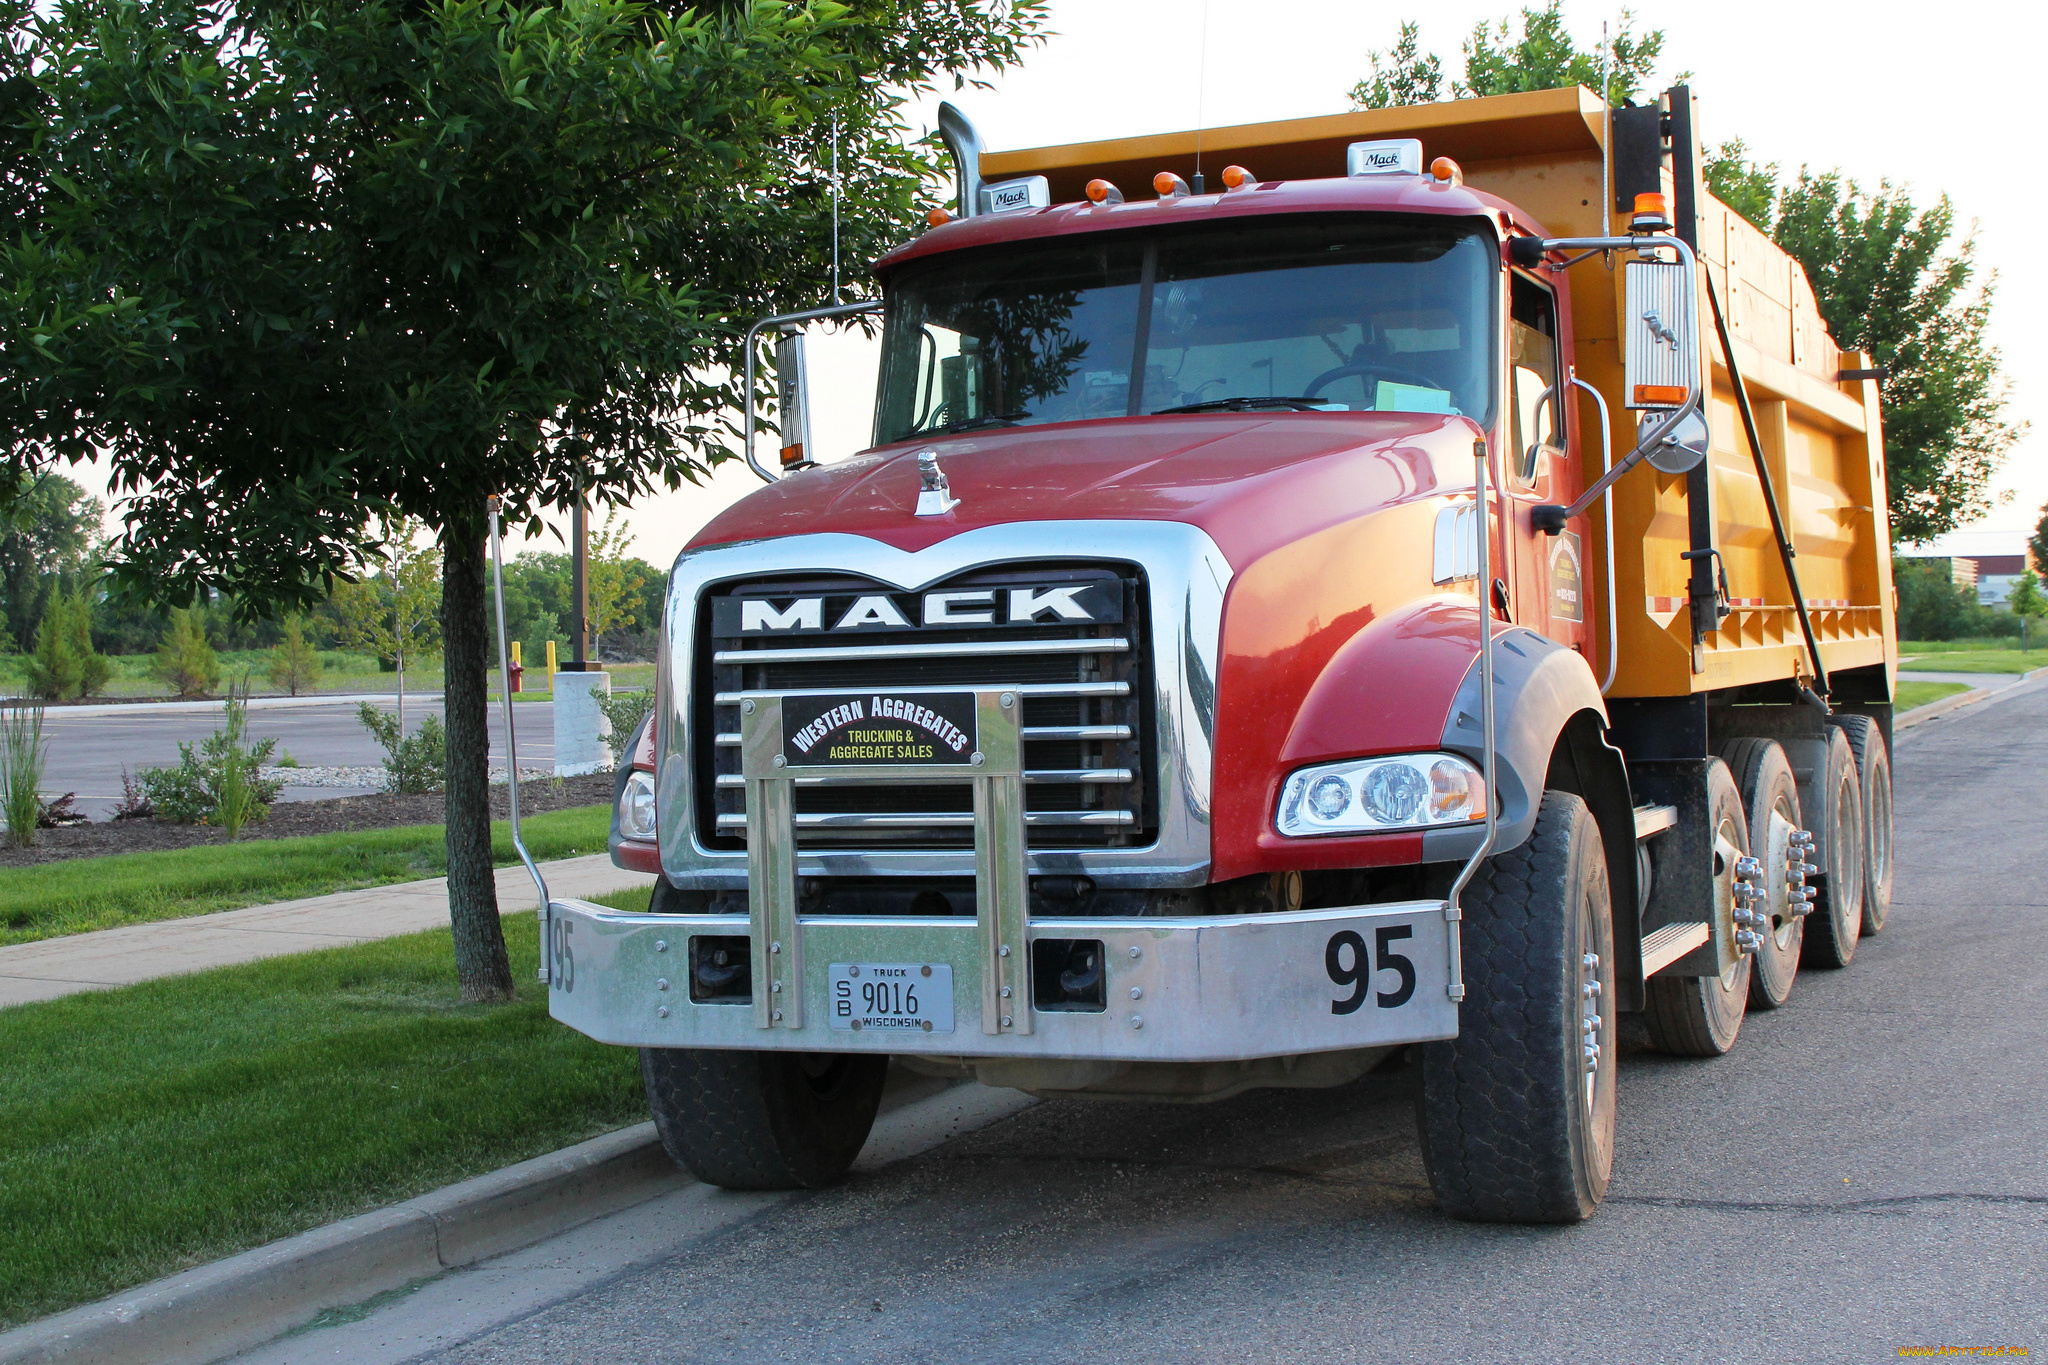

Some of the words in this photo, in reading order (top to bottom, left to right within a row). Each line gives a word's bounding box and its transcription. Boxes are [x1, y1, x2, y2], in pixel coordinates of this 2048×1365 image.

[1365, 153, 1400, 167] Mack
[995, 190, 1026, 206] Mack
[741, 585, 1095, 632] MACK
[791, 700, 865, 754] WESTERN
[871, 696, 969, 753] AGGREGATES
[848, 730, 903, 743] TRUCKING
[905, 730, 914, 742] &
[829, 746, 894, 759] AGGREGATE
[897, 745, 933, 758] SALES
[553, 917, 575, 993] 95
[873, 968, 907, 977] TRUCK
[1325, 924, 1416, 1015] 95
[862, 982, 918, 1015] 9016
[862, 1017, 922, 1028] WISCONSIN
